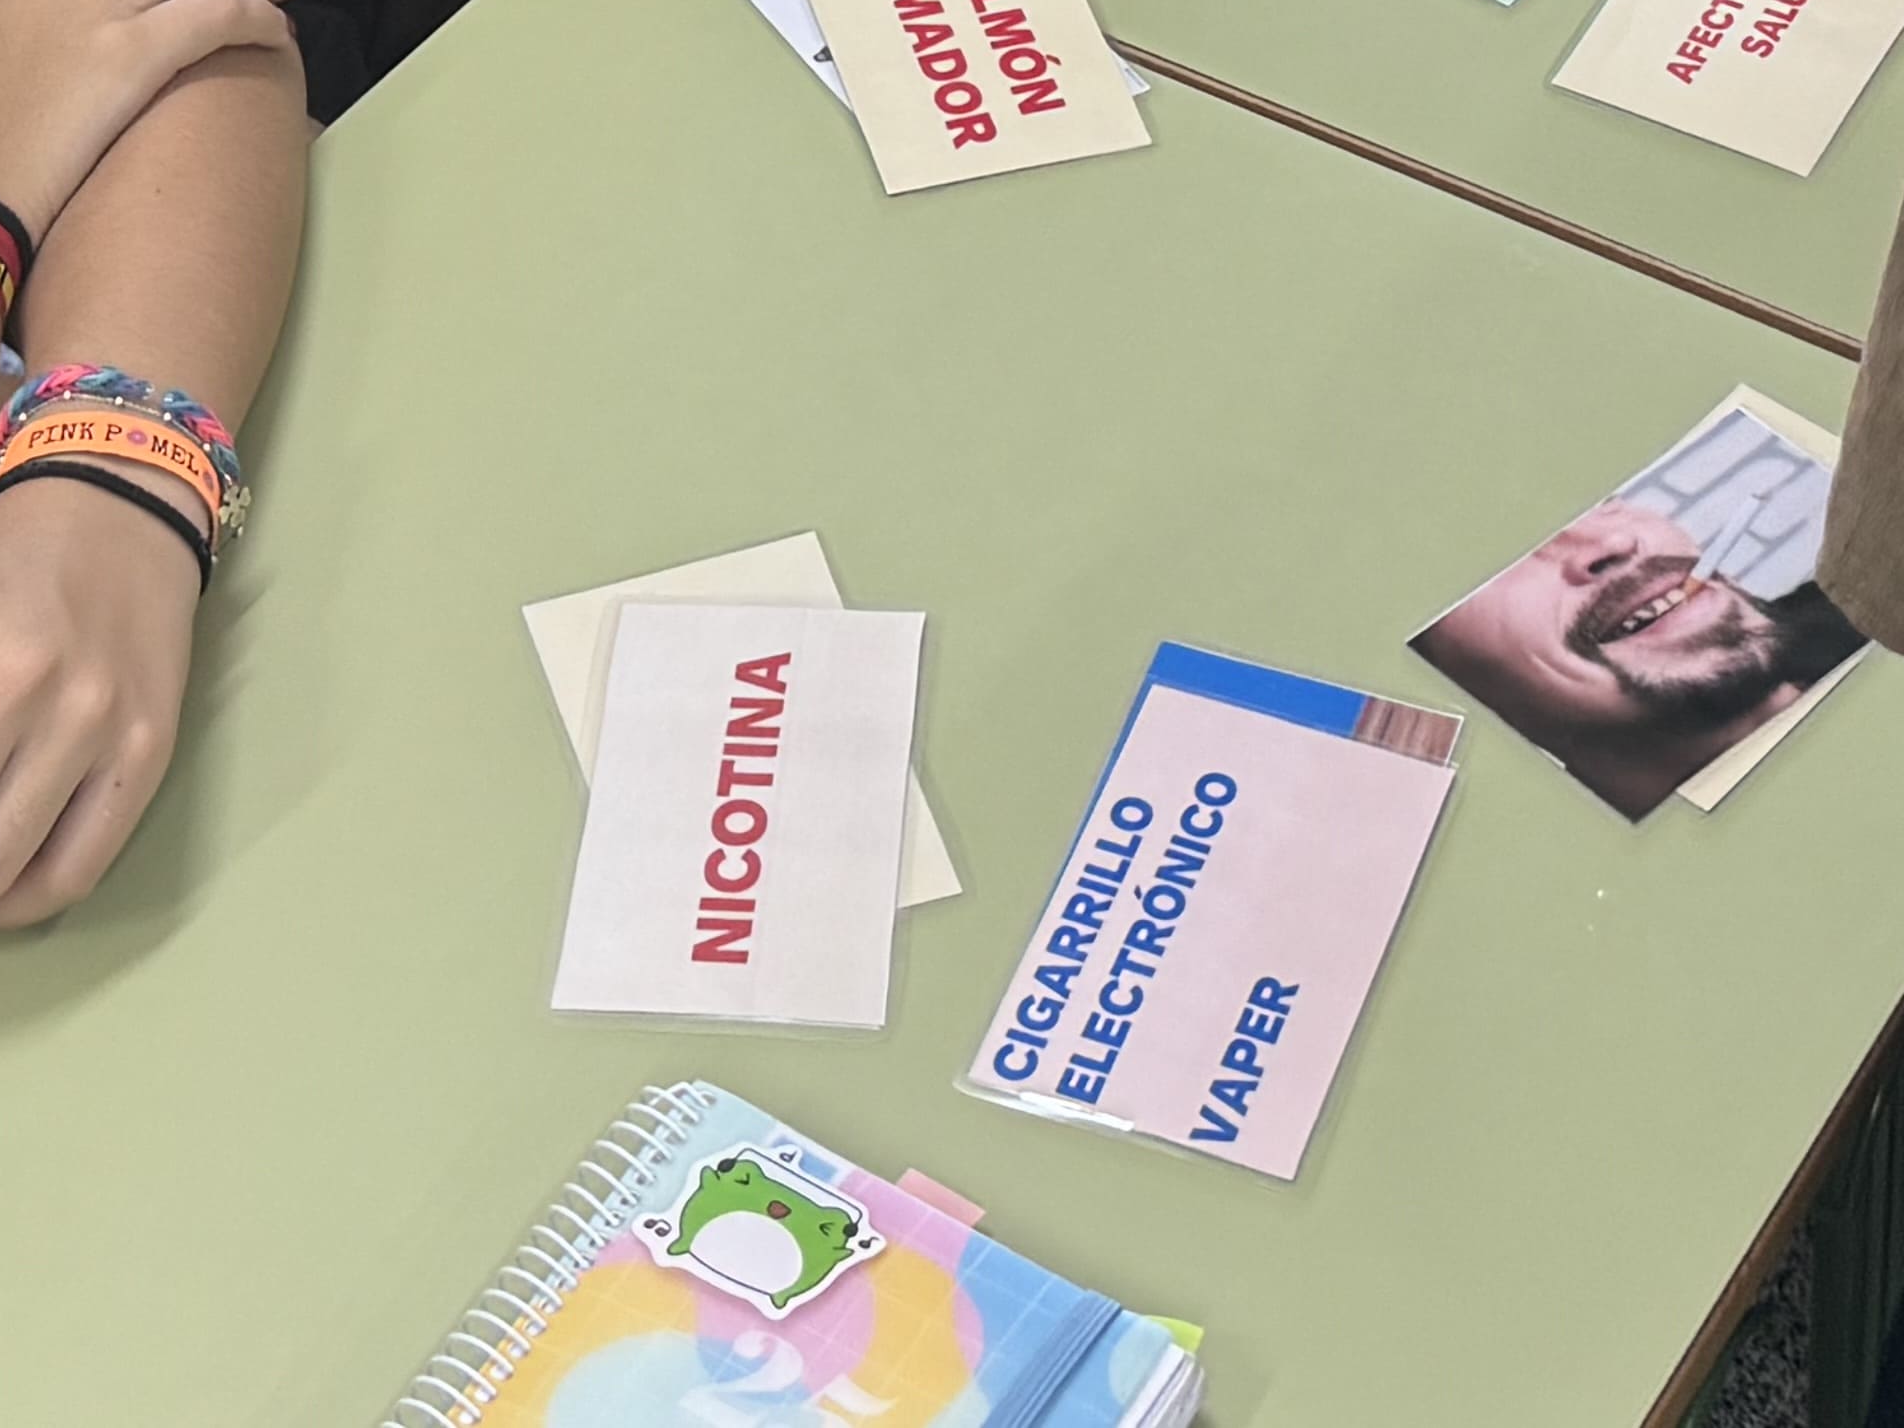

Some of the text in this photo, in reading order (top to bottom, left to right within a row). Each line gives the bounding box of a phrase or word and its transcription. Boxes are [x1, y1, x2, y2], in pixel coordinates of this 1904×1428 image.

[28, 422, 95, 449] PINK
[691, 651, 792, 964] NICOTINA
[992, 796, 1154, 1082] CIGARRILLO
[1055, 772, 1238, 1105] ELECTRÓNICO
[1189, 976, 1300, 1143] VAPER
